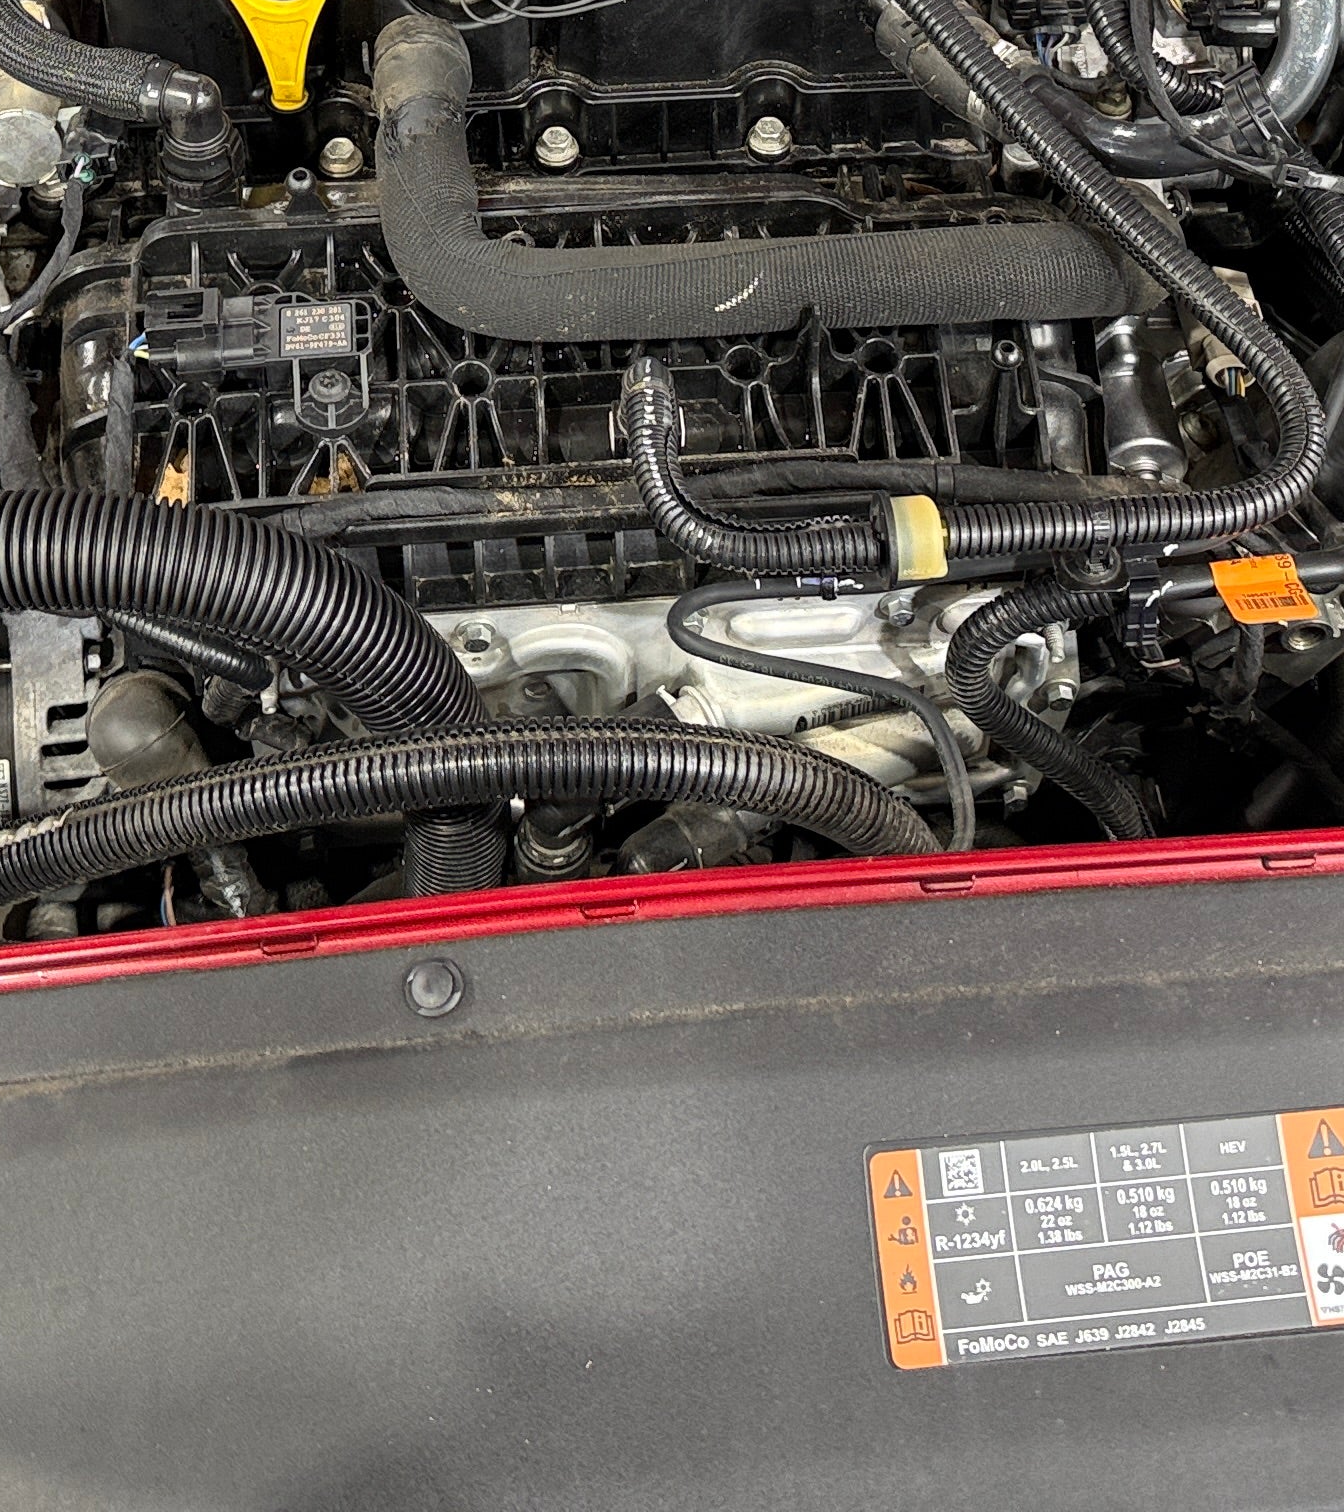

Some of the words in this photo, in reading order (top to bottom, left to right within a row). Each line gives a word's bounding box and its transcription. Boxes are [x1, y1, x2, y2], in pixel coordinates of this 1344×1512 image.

[1109, 1144, 1140, 1159] 1.5L,
[1140, 1141, 1168, 1156] 2.7L
[1219, 1140, 1247, 1154] HEV
[1019, 1159, 1050, 1173] 2.0L,
[1051, 1156, 1079, 1170] 2.5L
[1122, 1159, 1134, 1172] &
[1134, 1157, 1162, 1170] 3.0L
[1116, 1186, 1154, 1205] 0.510
[1156, 1185, 1176, 1203] kg
[1210, 1177, 1247, 1196] 0.510
[1248, 1177, 1268, 1195] kg
[1024, 1196, 1063, 1214] 0.624
[1064, 1194, 1084, 1213] kg
[1225, 1196, 1241, 1209] 18
[1242, 1196, 1258, 1208] oz
[1132, 1205, 1148, 1219] 18
[1149, 1205, 1165, 1218] oz
[1221, 1211, 1247, 1225] 1.12
[1247, 1209, 1267, 1223] lbs
[1039, 1214, 1056, 1229] 22
[1057, 1215, 1074, 1227] oz
[1127, 1222, 1153, 1236] 1.12
[1154, 1219, 1174, 1233] lbs
[934, 1229, 1007, 1252] R-1234yf
[1037, 1229, 1062, 1245] 1.38
[1064, 1228, 1084, 1242] lbs
[1232, 1250, 1271, 1269] POE
[1092, 1261, 1130, 1281] PAG
[1208, 1264, 1298, 1284] WSS-M2C31-B2
[1064, 1275, 1162, 1297] WSS-M2C300-A2
[957, 1334, 1029, 1356] FoMoCo
[1036, 1331, 1069, 1348] SAE
[1075, 1327, 1110, 1344] J639
[1114, 1322, 1156, 1339] J2842
[1164, 1317, 1206, 1334] J2845
